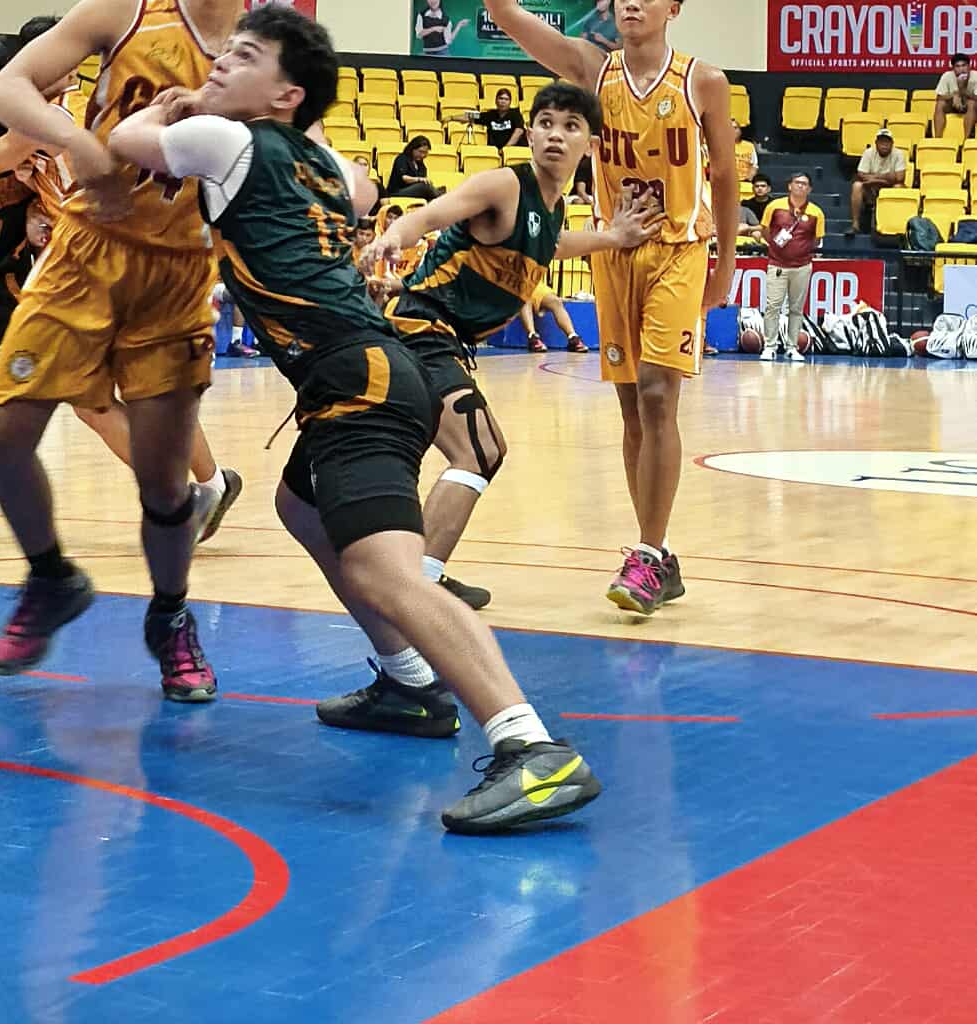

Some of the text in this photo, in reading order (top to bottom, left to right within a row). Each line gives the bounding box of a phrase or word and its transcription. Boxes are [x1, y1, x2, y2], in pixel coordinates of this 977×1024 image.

[791, 59, 824, 67] OFFICIAL
[828, 59, 857, 67] SPORTS
[860, 59, 894, 67] APPAREL
[897, 59, 932, 68] PARTNER
[599, 124, 640, 170] CIT
[666, 126, 689, 167] U
[679, 330, 694, 355] 2
